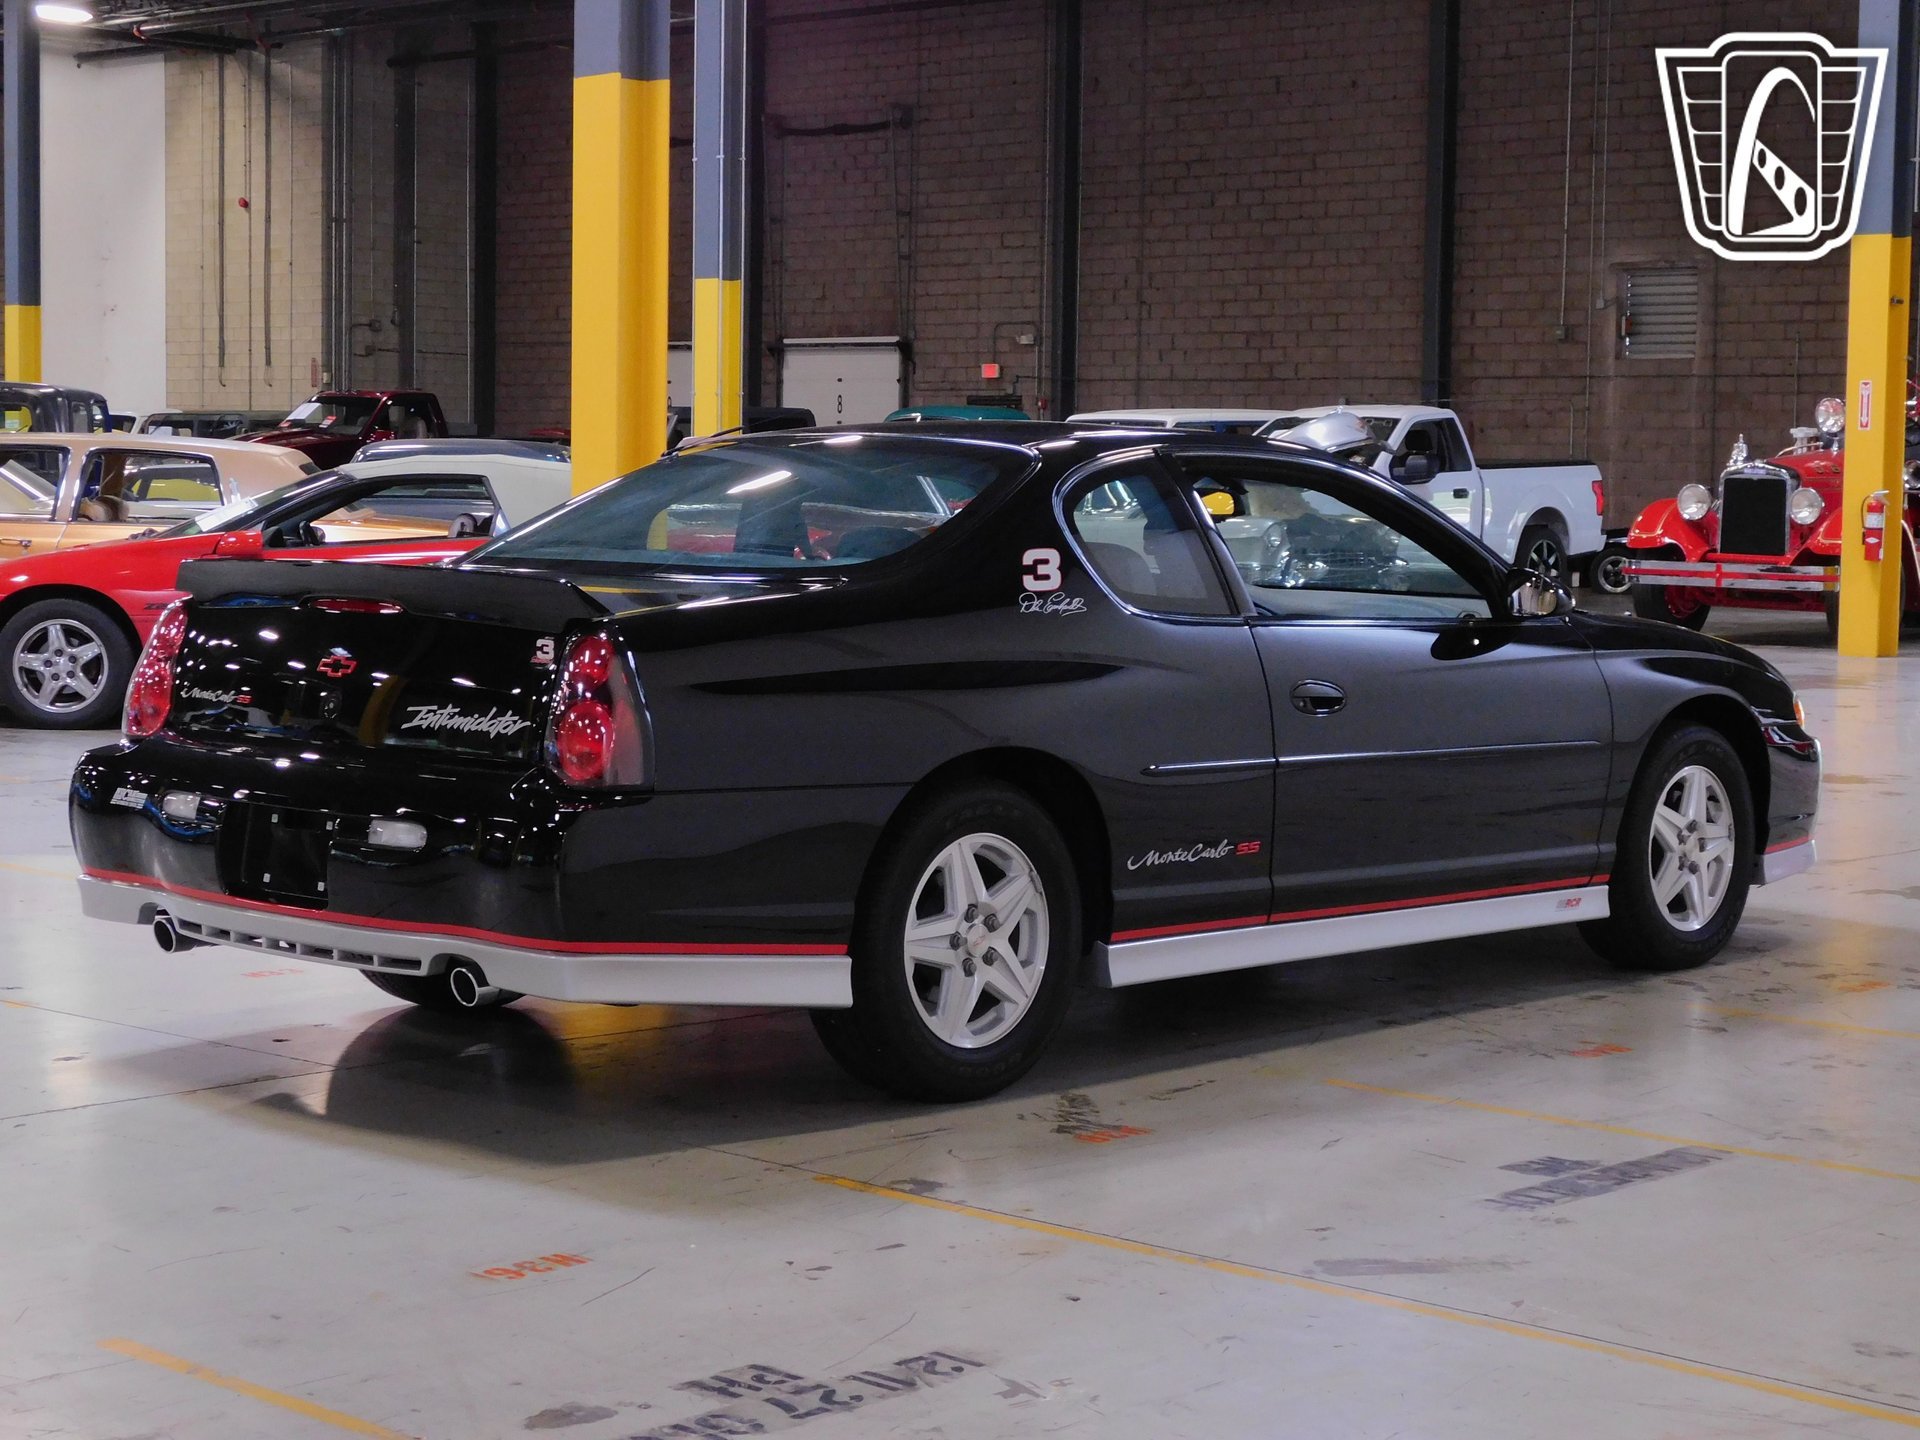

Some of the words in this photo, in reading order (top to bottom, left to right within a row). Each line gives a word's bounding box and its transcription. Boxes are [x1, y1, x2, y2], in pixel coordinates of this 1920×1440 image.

[837, 394, 843, 414] 8
[1022, 547, 1062, 592] 3
[535, 638, 555, 661] 3
[400, 703, 532, 740] Intimidator
[1235, 840, 1261, 856] SS
